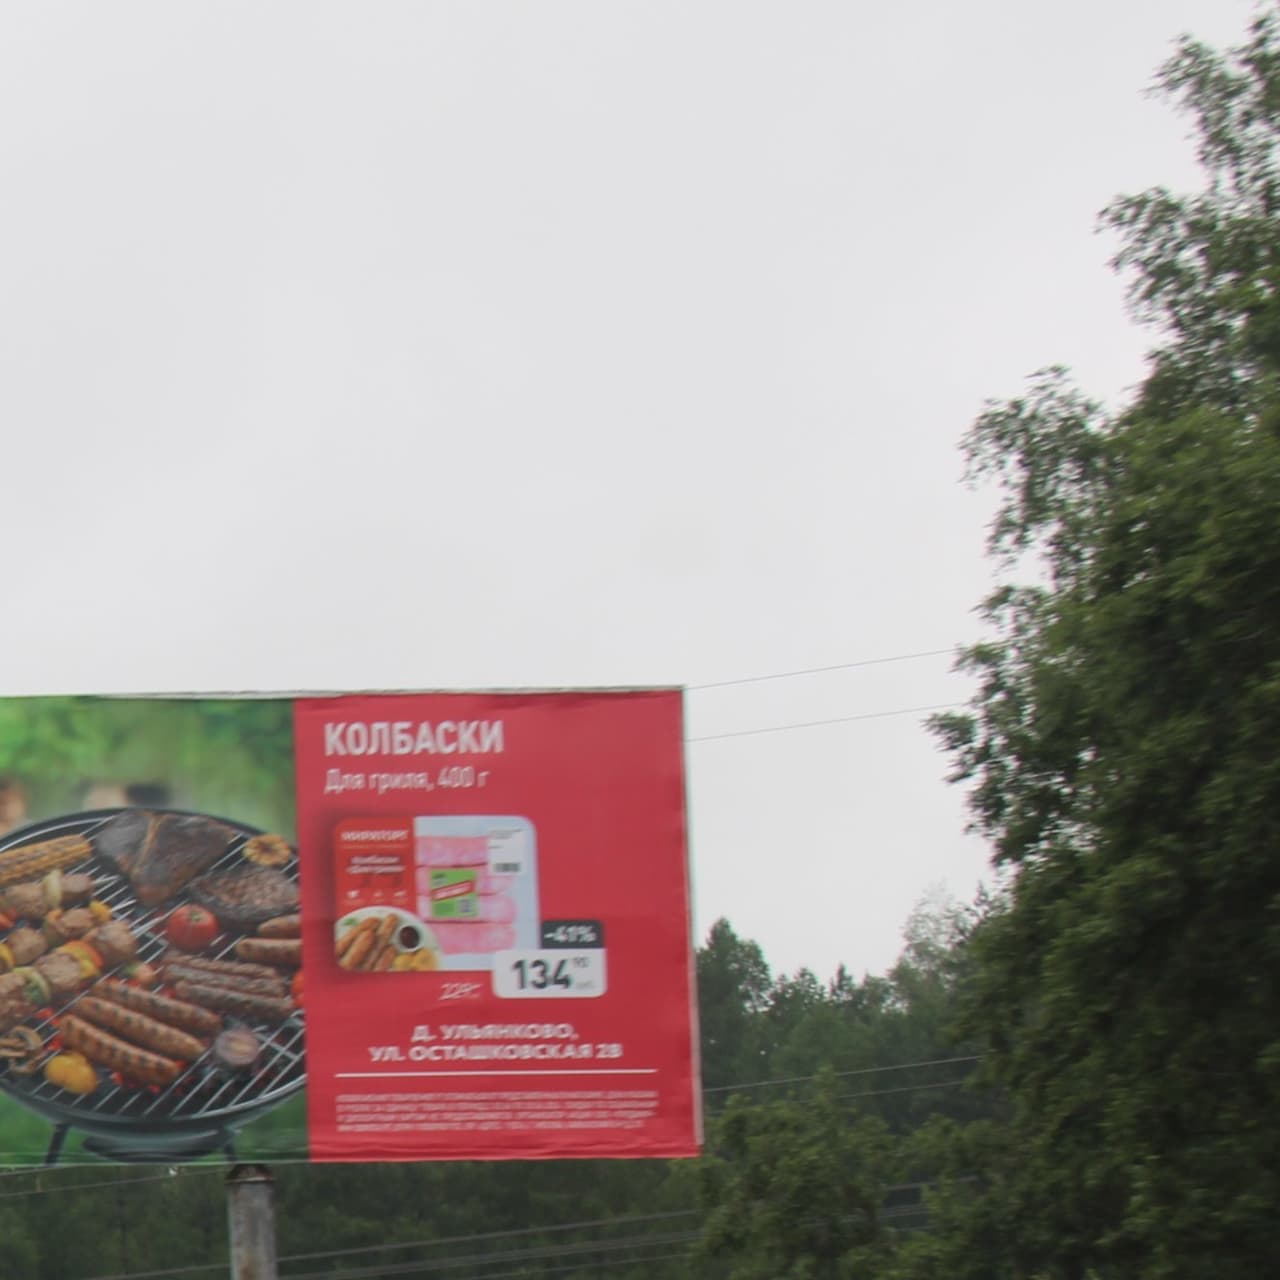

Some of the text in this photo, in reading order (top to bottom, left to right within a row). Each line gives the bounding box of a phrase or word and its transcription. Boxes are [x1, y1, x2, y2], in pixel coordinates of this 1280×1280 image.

[324, 720, 504, 756] КОЛБАСКИ
[324, 766, 490, 795] Для гриля, 400 г
[512, 958, 571, 990] 134
[369, 1046, 405, 1062] УЛ.
[408, 1044, 592, 1061] ОСТАШКОВСКАЯ
